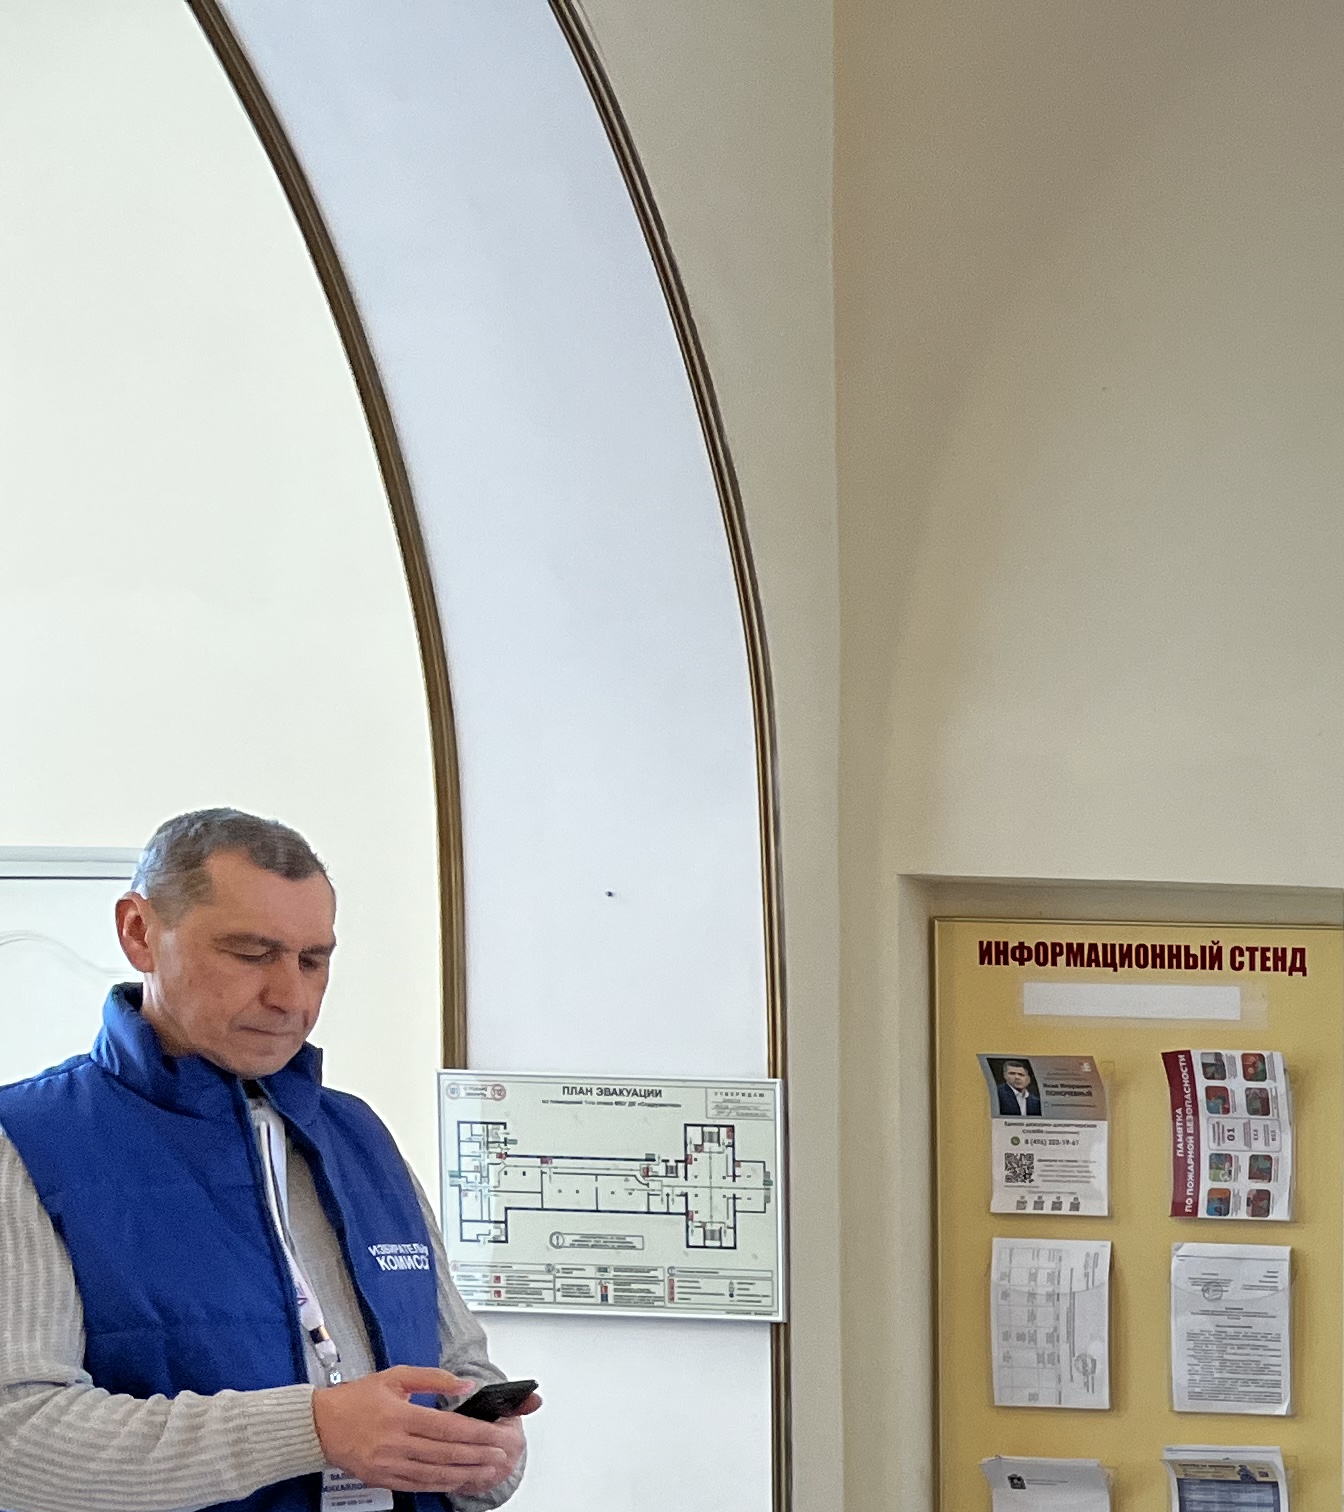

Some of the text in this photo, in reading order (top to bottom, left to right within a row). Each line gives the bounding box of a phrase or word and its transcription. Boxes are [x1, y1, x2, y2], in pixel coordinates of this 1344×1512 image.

[978, 940, 1307, 976] ИНФОРМАЦИОННЫЙ СТЕНД
[562, 1086, 663, 1100] ПЛАН ЭВАКУАЦИИ
[1176, 1107, 1184, 1157] ПАМЯТКА
[1177, 1054, 1194, 1213] ПО ПОЖАРНОЙ БЕЗОПАСНОСТИ
